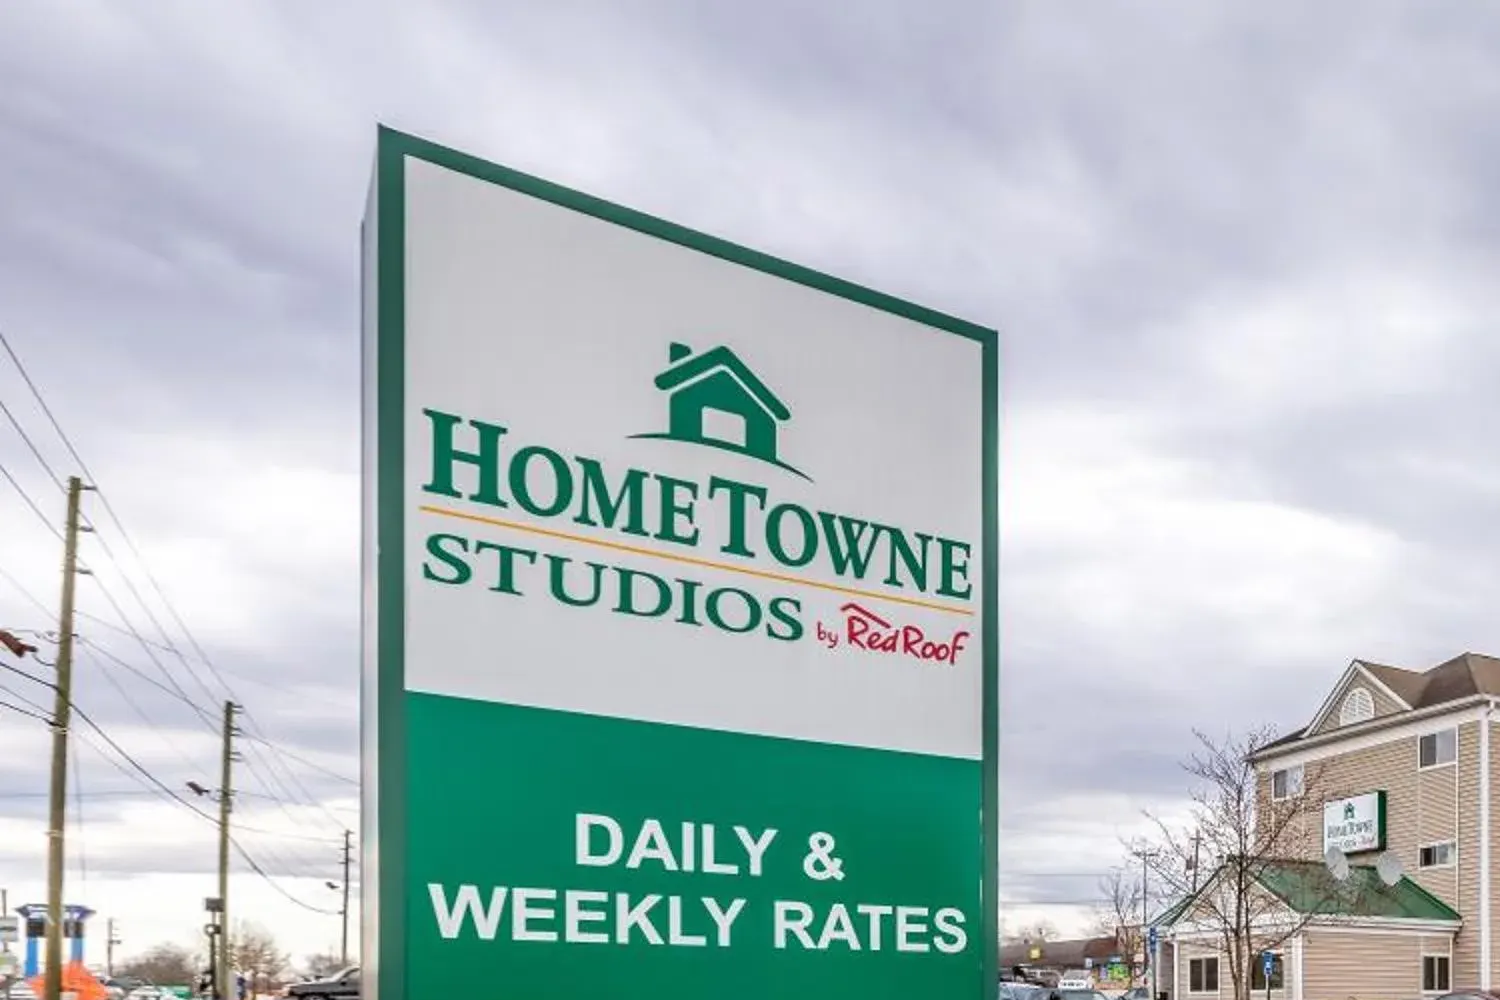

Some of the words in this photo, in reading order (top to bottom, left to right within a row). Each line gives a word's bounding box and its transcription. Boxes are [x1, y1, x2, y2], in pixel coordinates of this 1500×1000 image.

[422, 408, 972, 601] HOMETOWNE
[423, 533, 804, 641] STUDIOS
[817, 621, 838, 649] by
[576, 813, 777, 876] DAILY
[803, 831, 846, 881] &
[428, 884, 746, 947] WEEKLY
[774, 901, 967, 953] RATES
